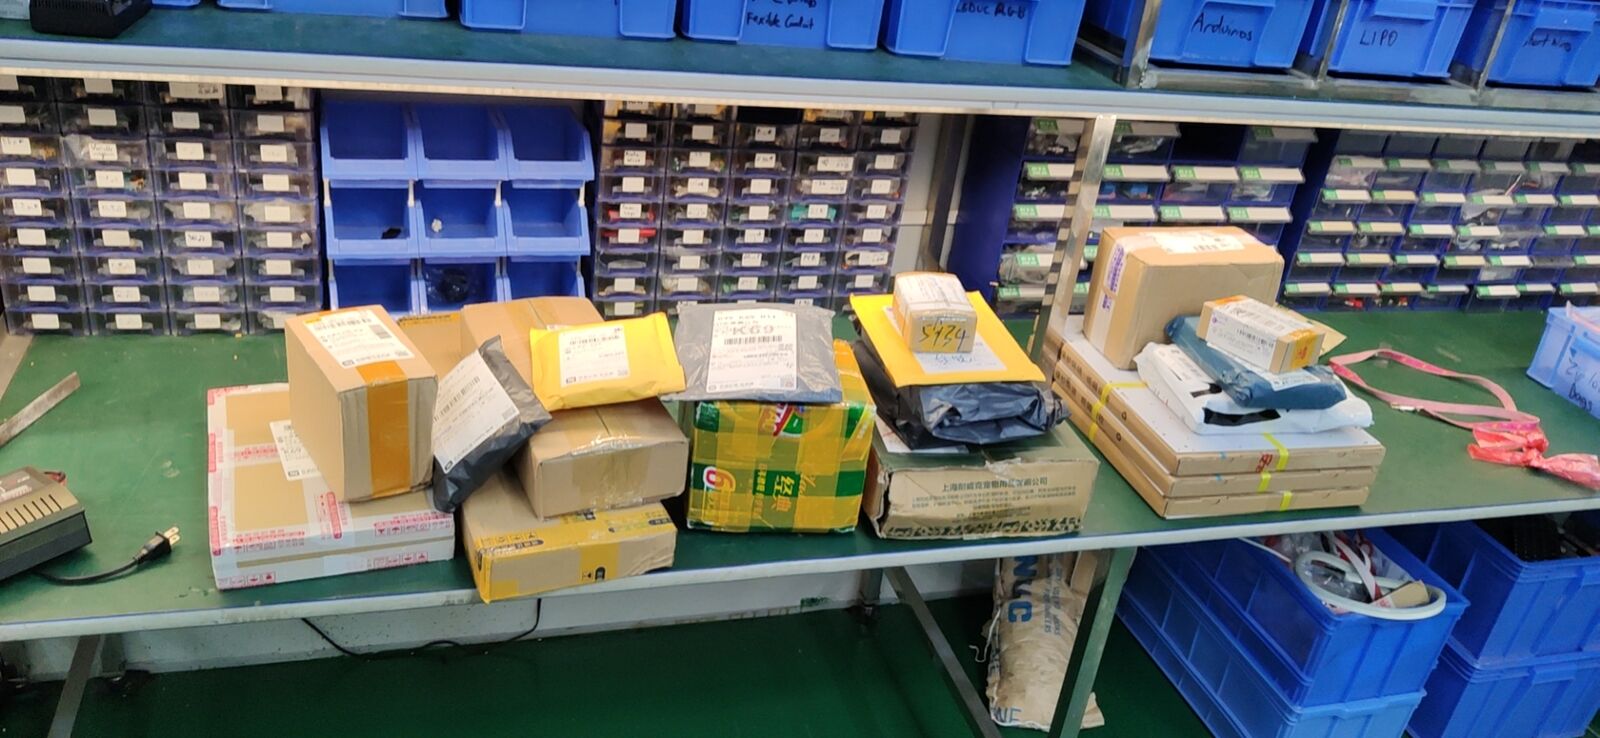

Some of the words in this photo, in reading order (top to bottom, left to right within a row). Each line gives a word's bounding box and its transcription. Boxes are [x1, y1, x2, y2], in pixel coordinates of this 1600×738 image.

[1190, 12, 1253, 41] Arduinos
[1359, 28, 1399, 47] LIPO
[703, 466, 736, 491] 6
[772, 476, 796, 512] 经典
